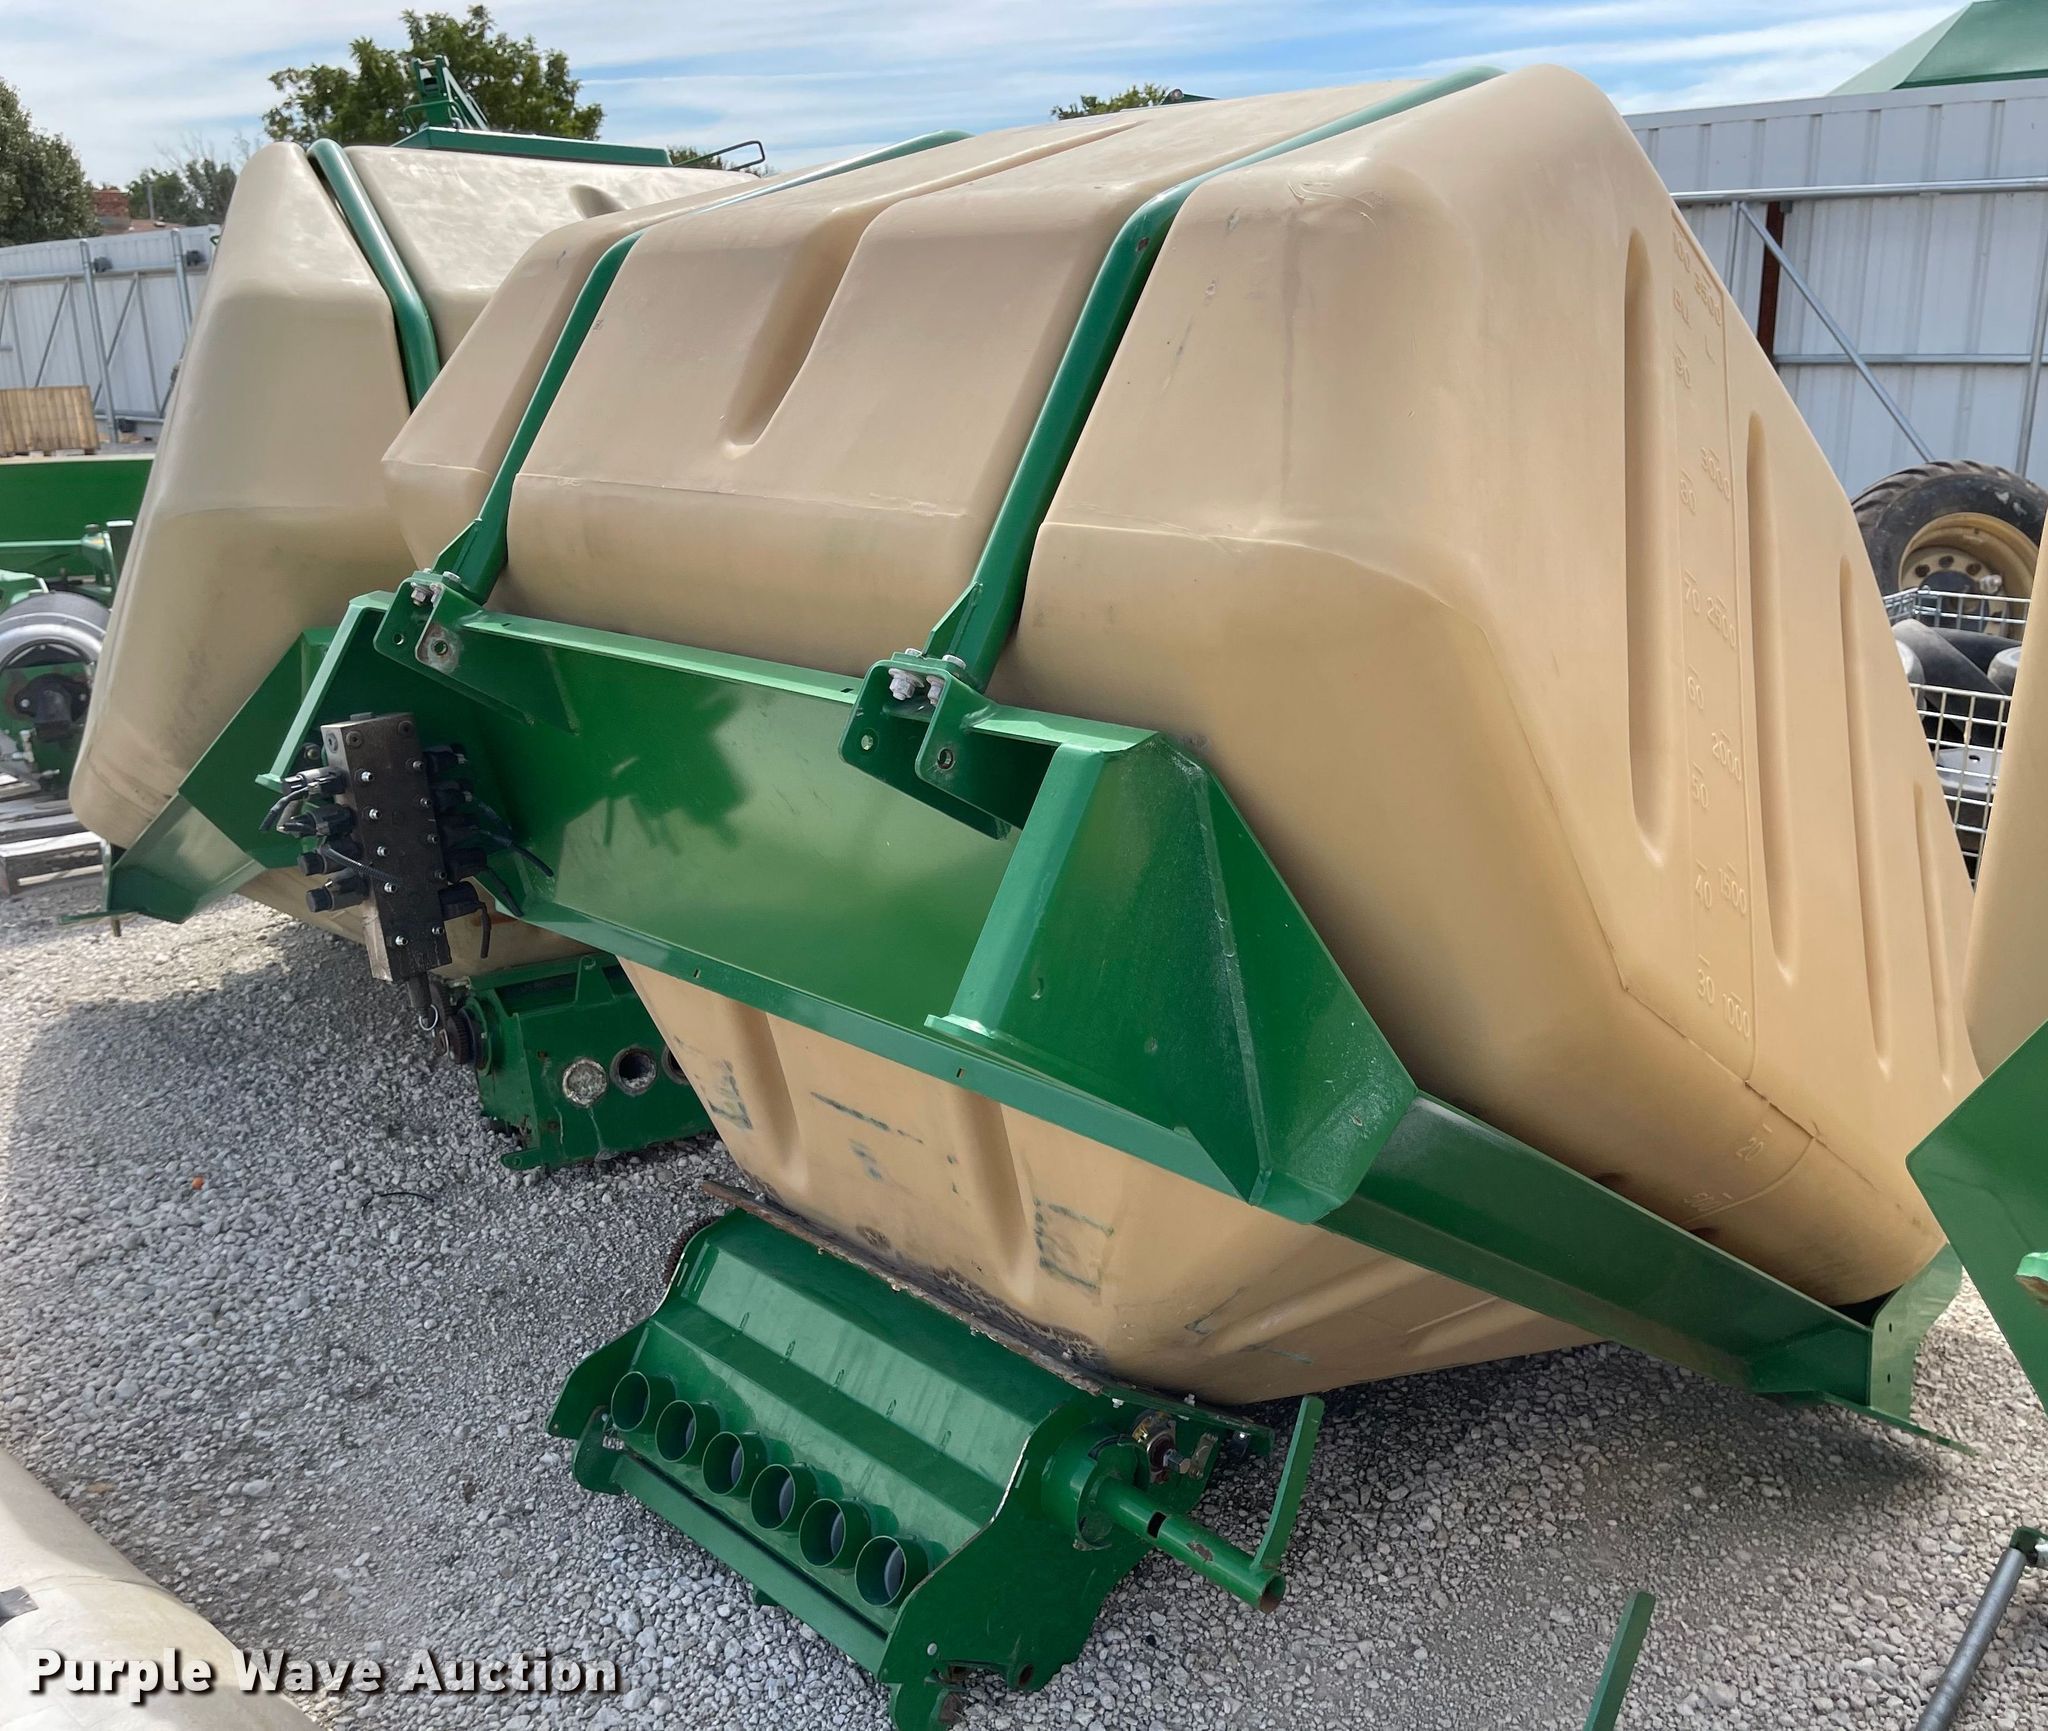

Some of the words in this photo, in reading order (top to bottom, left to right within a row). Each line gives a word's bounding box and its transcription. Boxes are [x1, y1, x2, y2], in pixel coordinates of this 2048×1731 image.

[1673, 351, 1692, 390] 90
[1700, 446, 1732, 502] 3000
[1679, 478, 1697, 516] 80
[1683, 574, 1700, 616] 70
[1706, 596, 1737, 649] 2500
[1687, 675, 1705, 711] 60
[1711, 732, 1743, 782] 2000
[1691, 773, 1709, 809] 50
[1695, 874, 1713, 909] 40
[1718, 867, 1748, 916] 1500
[1696, 968, 1716, 1005] 30
[1722, 992, 1751, 1039] 1000
[1735, 1136, 1764, 1162] 20
